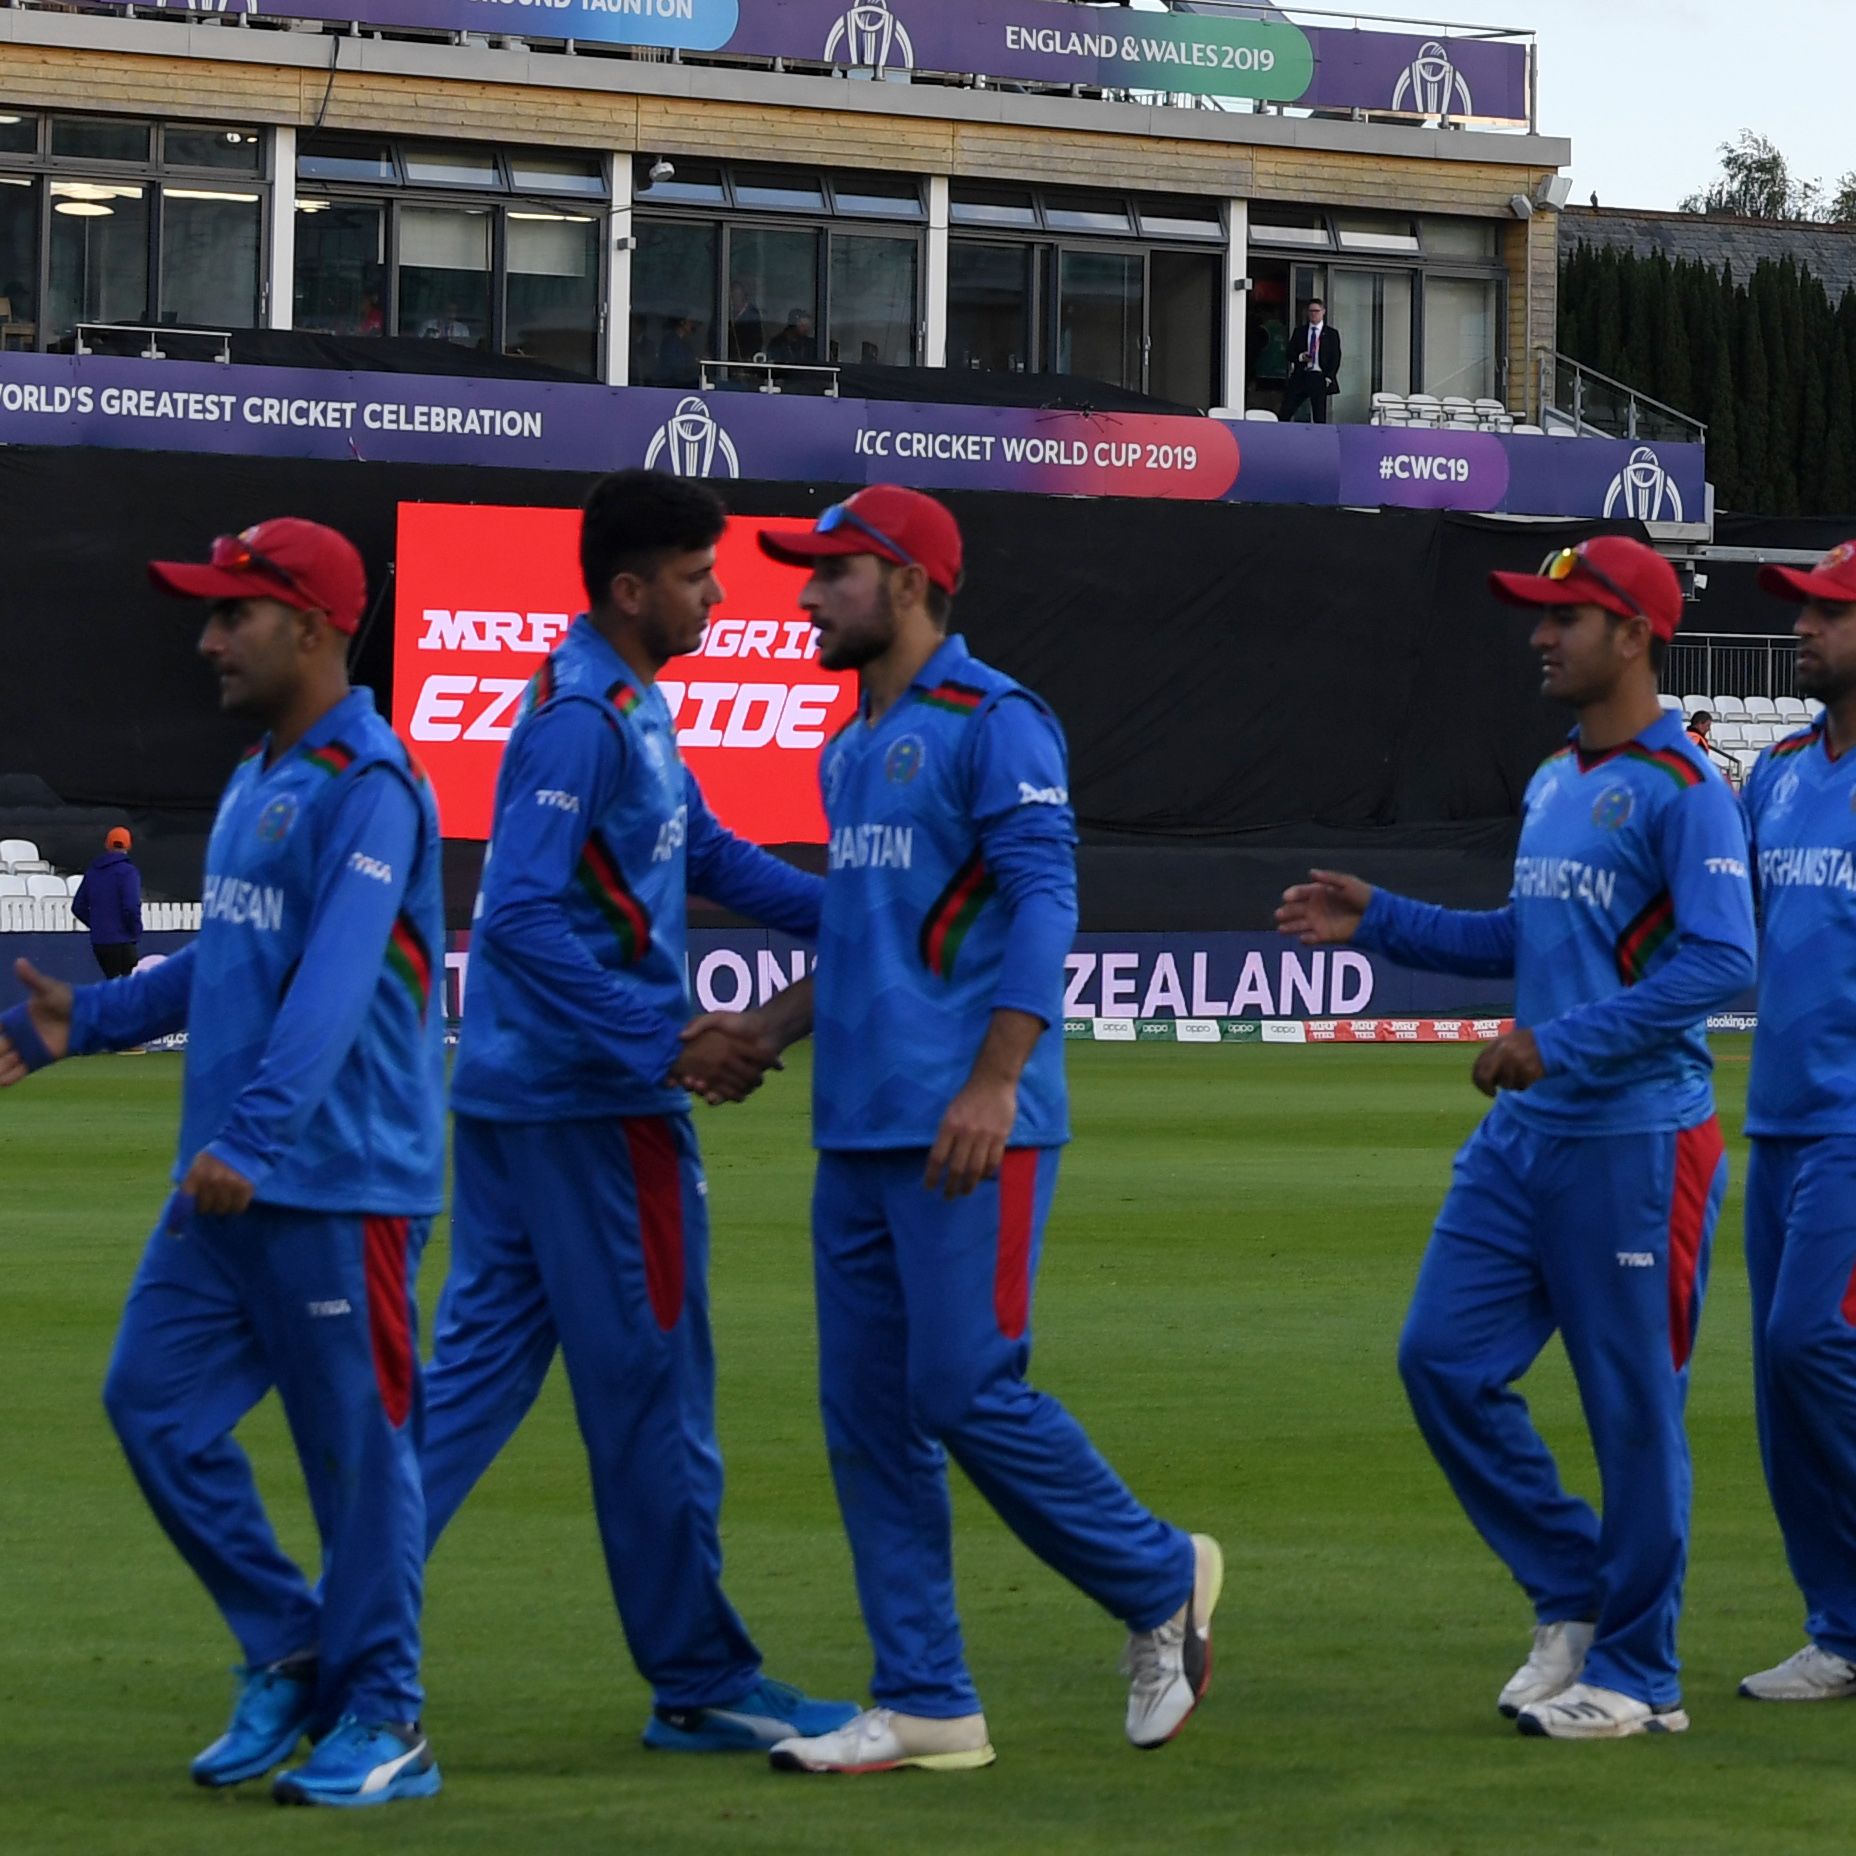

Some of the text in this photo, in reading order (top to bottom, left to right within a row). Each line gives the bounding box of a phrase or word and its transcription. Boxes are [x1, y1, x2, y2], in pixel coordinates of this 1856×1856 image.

[1005, 25, 1275, 72] ENGLAND & WALES 2019
[0, 383, 542, 438] ORLD'S GREATEST CRICKET CELEBRATION
[854, 428, 1197, 470] ICC CRICKET WORLD CUP 2019
[1379, 454, 1469, 482] #CWC19
[418, 609, 569, 653] MRF
[1063, 951, 1374, 1018] ZEALAND
